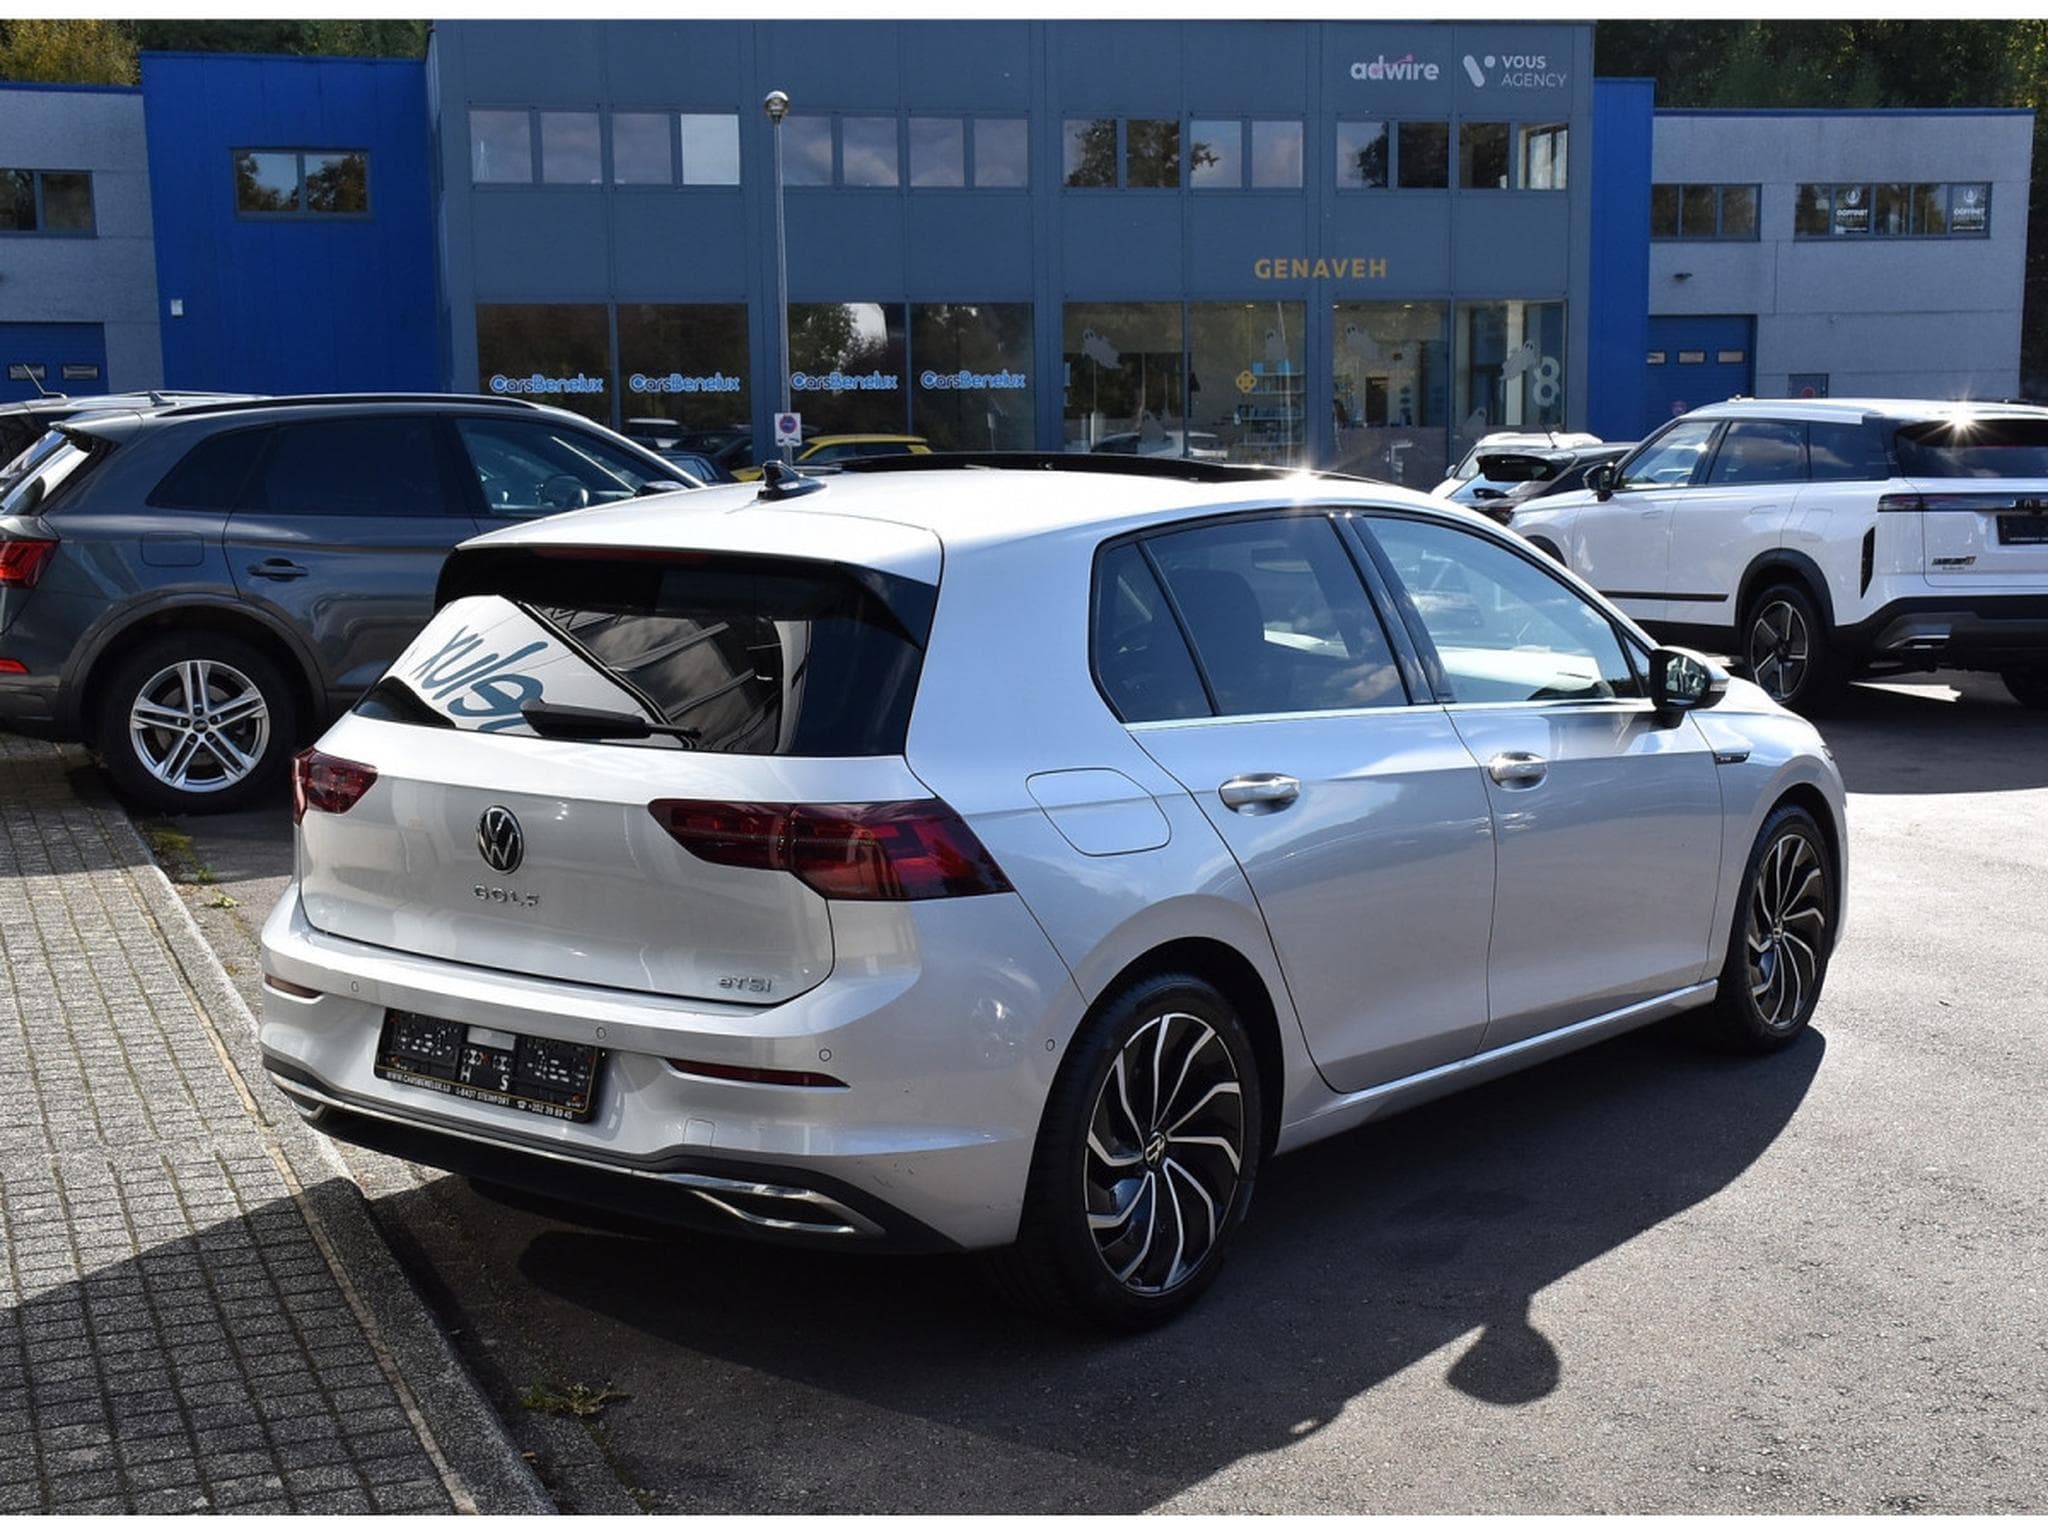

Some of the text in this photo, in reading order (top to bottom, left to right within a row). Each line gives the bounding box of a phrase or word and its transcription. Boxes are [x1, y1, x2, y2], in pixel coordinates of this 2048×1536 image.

[1350, 54, 1440, 81] adwire
[1501, 55, 1547, 69] VOUS
[1501, 72, 1567, 88] AGENCY
[1254, 258, 1388, 279] GENAVEH
[490, 373, 604, 393] CarsBenelux
[629, 372, 740, 393] CarsBenelux
[791, 370, 898, 390] CarsBenelux
[920, 369, 1025, 390] CarsBenelux
